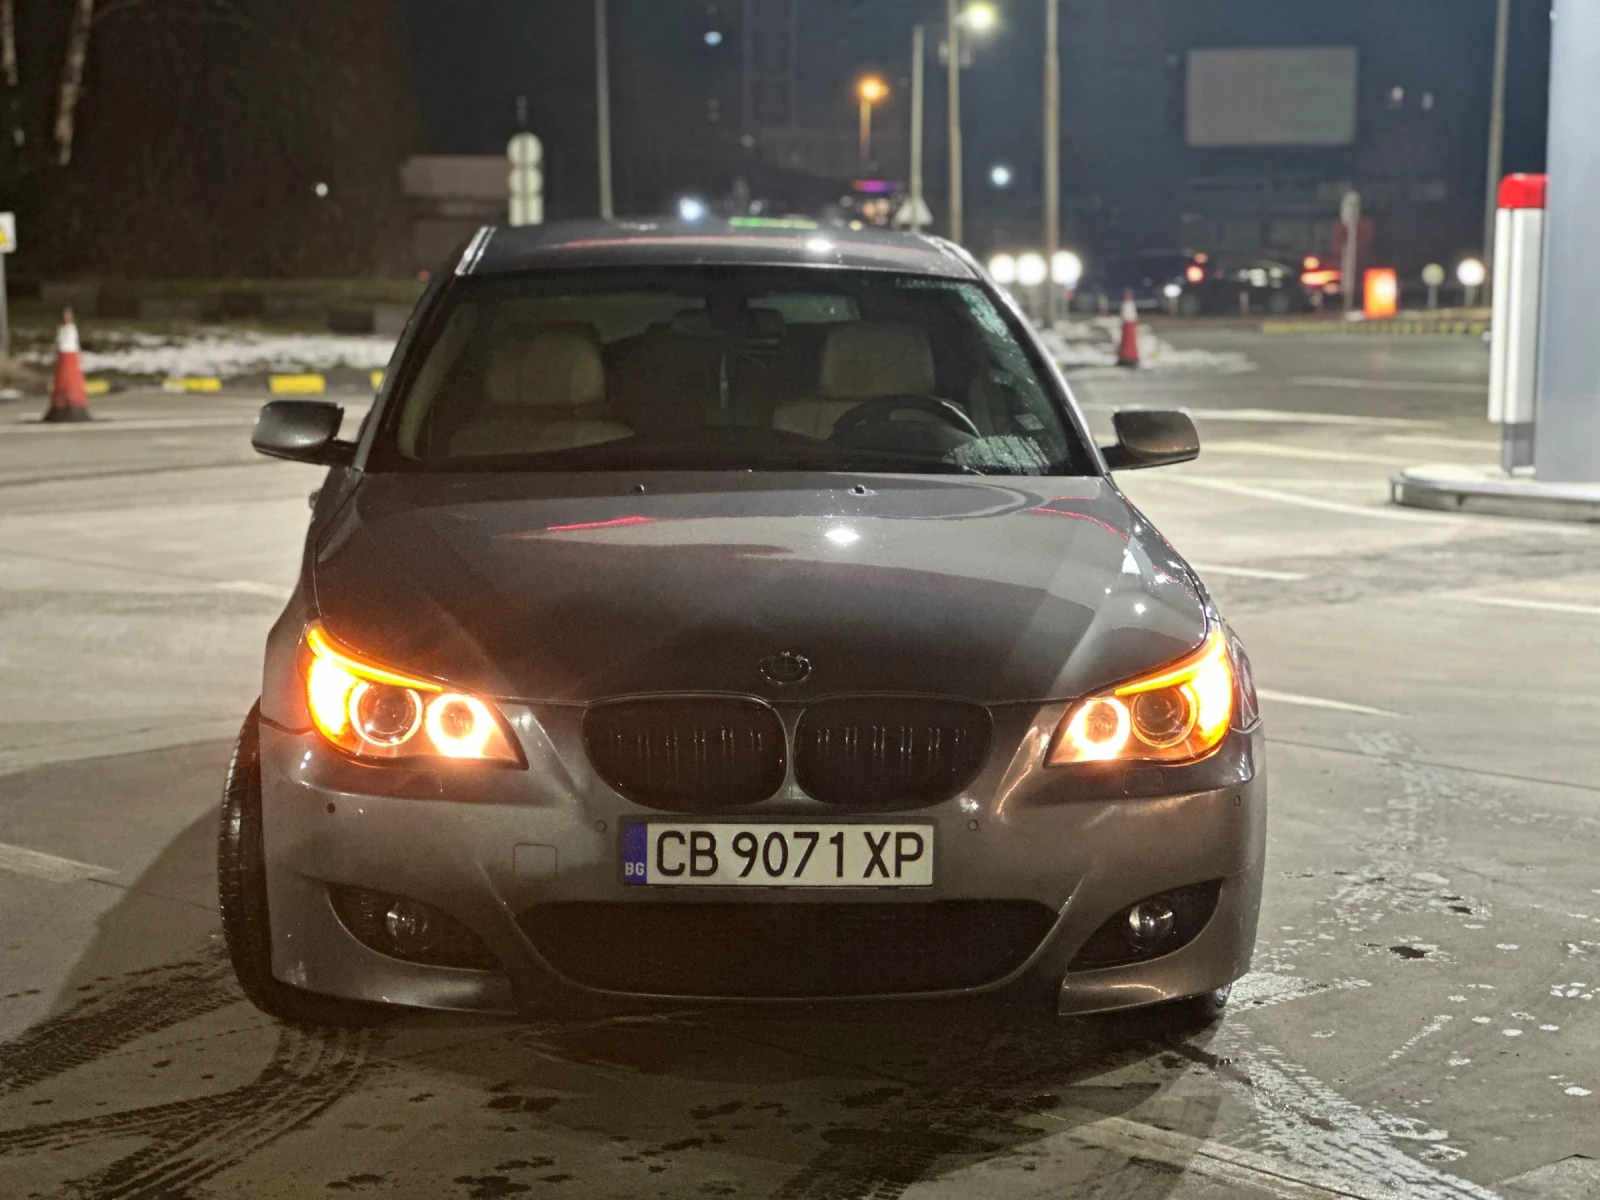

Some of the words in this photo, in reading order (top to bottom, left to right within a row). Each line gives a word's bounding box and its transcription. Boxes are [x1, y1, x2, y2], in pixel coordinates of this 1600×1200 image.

[625, 861, 645, 876] BG
[656, 830, 719, 877] CB
[731, 831, 844, 878] 9071
[862, 831, 924, 878] XP
